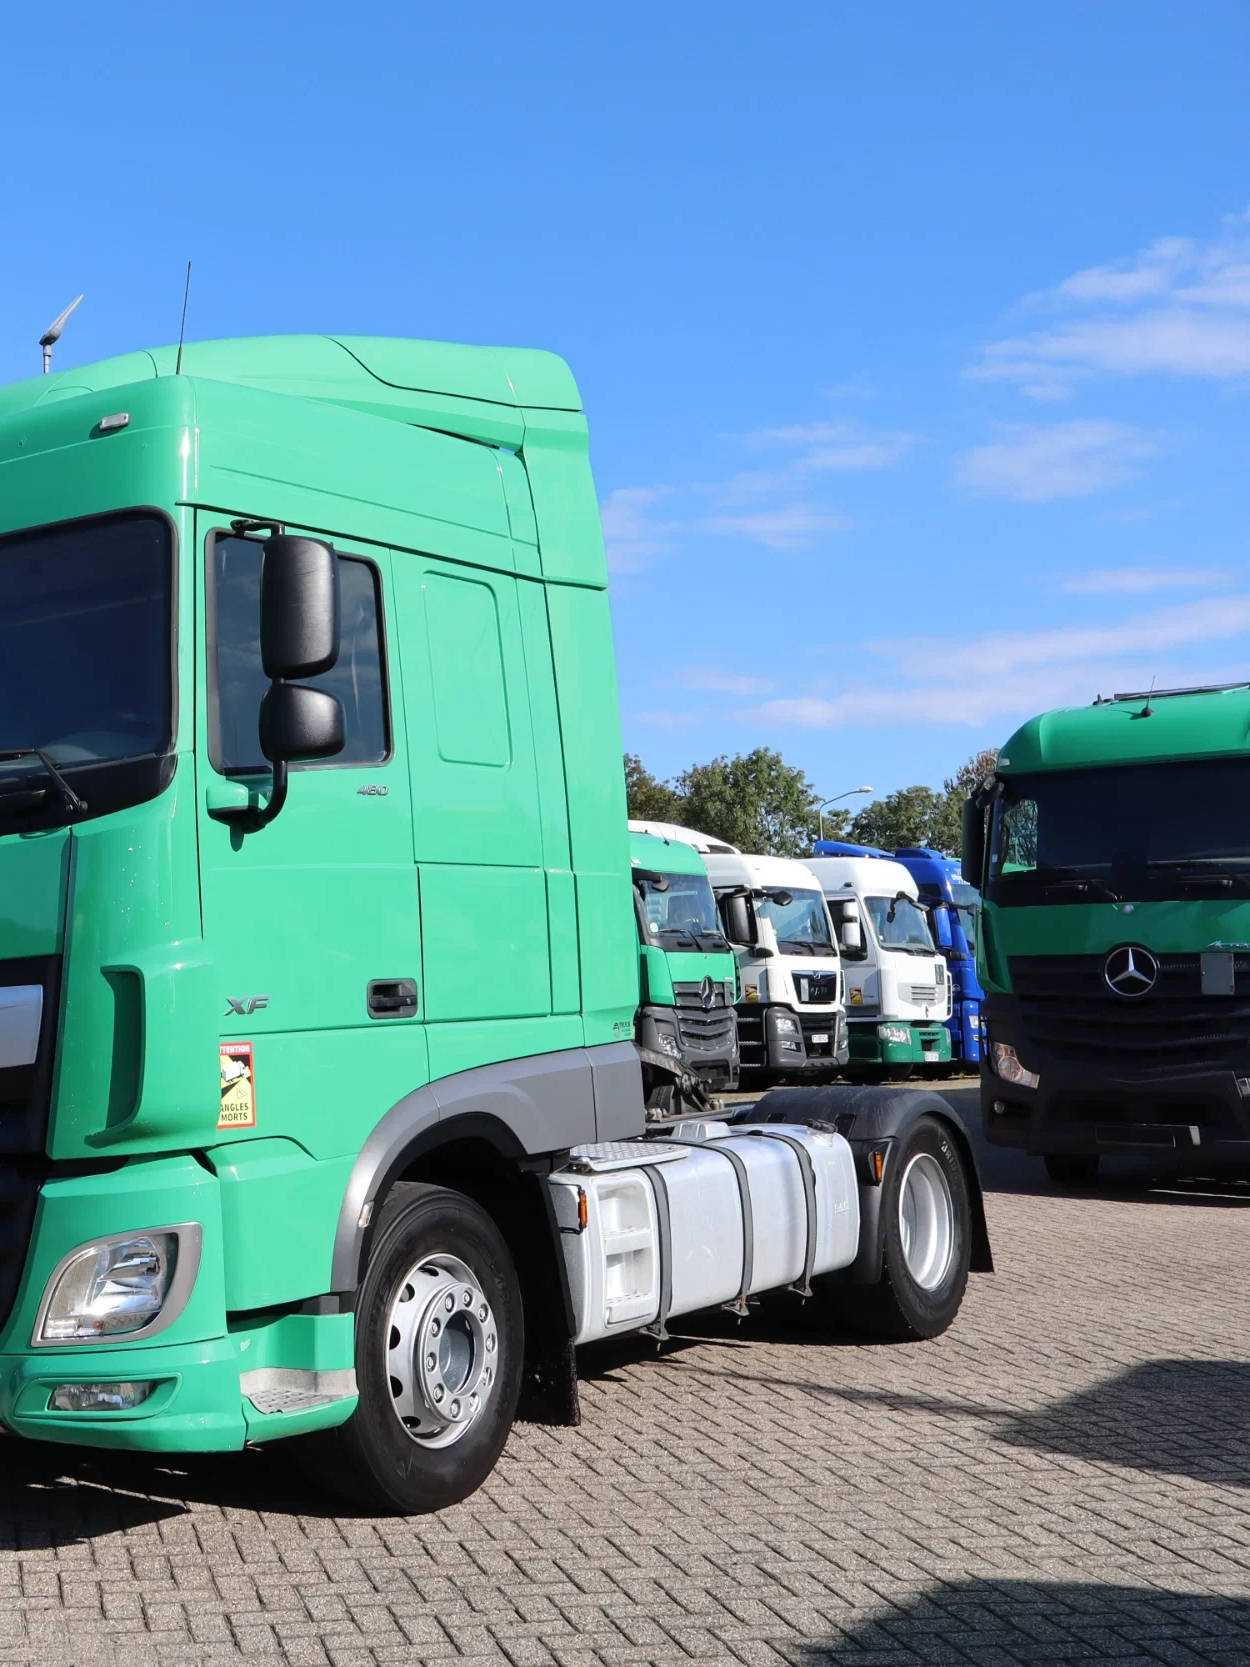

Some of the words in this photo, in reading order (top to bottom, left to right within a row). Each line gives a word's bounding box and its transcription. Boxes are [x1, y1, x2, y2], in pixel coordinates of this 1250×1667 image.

[223, 995, 271, 1016] XF
[219, 1044, 250, 1054] TTENTION
[220, 1102, 249, 1112] ANGLES
[221, 1112, 248, 1122] MORTS
